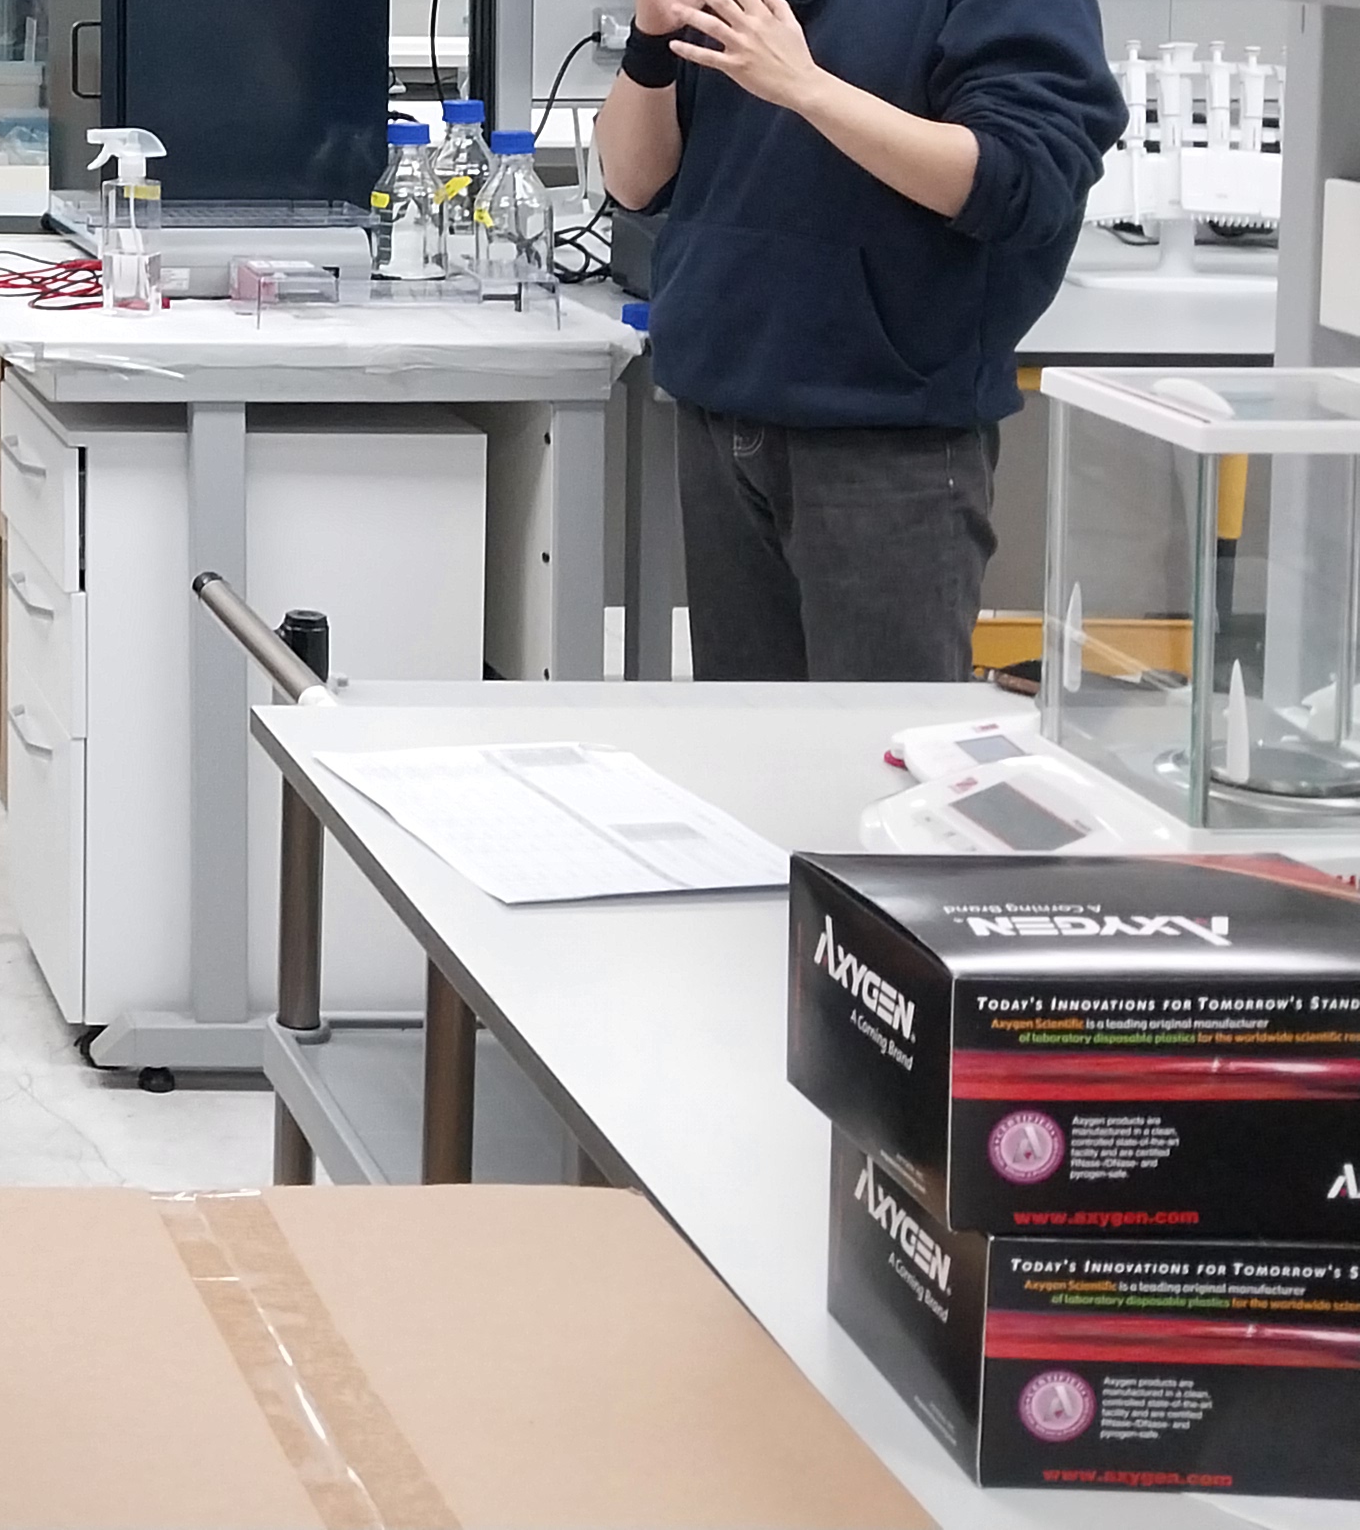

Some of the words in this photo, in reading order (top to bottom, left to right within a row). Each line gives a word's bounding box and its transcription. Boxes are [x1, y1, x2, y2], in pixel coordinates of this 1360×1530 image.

[943, 904, 1002, 915] Brand
[1005, 903, 1084, 915] Corning
[967, 915, 1232, 946] AXYGEN
[814, 914, 915, 1039] AXYGEN
[977, 996, 1043, 1011] TODAY'S
[1051, 996, 1156, 1011] INNOVATIONS
[1163, 999, 1192, 1011] FOR
[1198, 995, 1303, 1011] TOMORROW'S
[991, 1019, 1033, 1031] Axygen
[1035, 1019, 1084, 1030] Scientific
[1086, 1019, 1095, 1030] is
[1106, 1019, 1147, 1032] leading
[1148, 1019, 1192, 1031] original
[1194, 1019, 1269, 1030] manufacturer
[857, 1015, 888, 1055] Corning
[888, 1039, 914, 1071] Brand
[1018, 1032, 1030, 1043] of
[1032, 1032, 1092, 1044] laboratory
[1093, 1032, 1152, 1044] disposable
[1155, 1032, 1196, 1044] plastics
[1215, 1033, 1232, 1043] the
[1235, 1033, 1293, 1043] worldwide
[1295, 1033, 1342, 1043] scientific
[854, 1154, 951, 1292] AXYGEN
[1013, 1211, 1199, 1228] www.axygen.com
[1010, 1258, 1076, 1273] TODAY'S
[1084, 1260, 1190, 1276] INNOVATIONS
[1197, 1264, 1227, 1275] FOR
[1233, 1262, 1342, 1279] TOMORROW'S
[1118, 1281, 1128, 1292] is
[1139, 1282, 1181, 1294] leading
[1182, 1283, 1226, 1295] original
[1228, 1284, 1306, 1296] manufacturer
[1051, 1293, 1063, 1304] of
[1064, 1293, 1125, 1306] laboratory
[1125, 1295, 1186, 1308] disposable
[1188, 1297, 1230, 1309] plastics
[1250, 1298, 1269, 1309] the
[1270, 1299, 1331, 1311] worldwide
[1043, 1469, 1233, 1487] www.axygen.com
